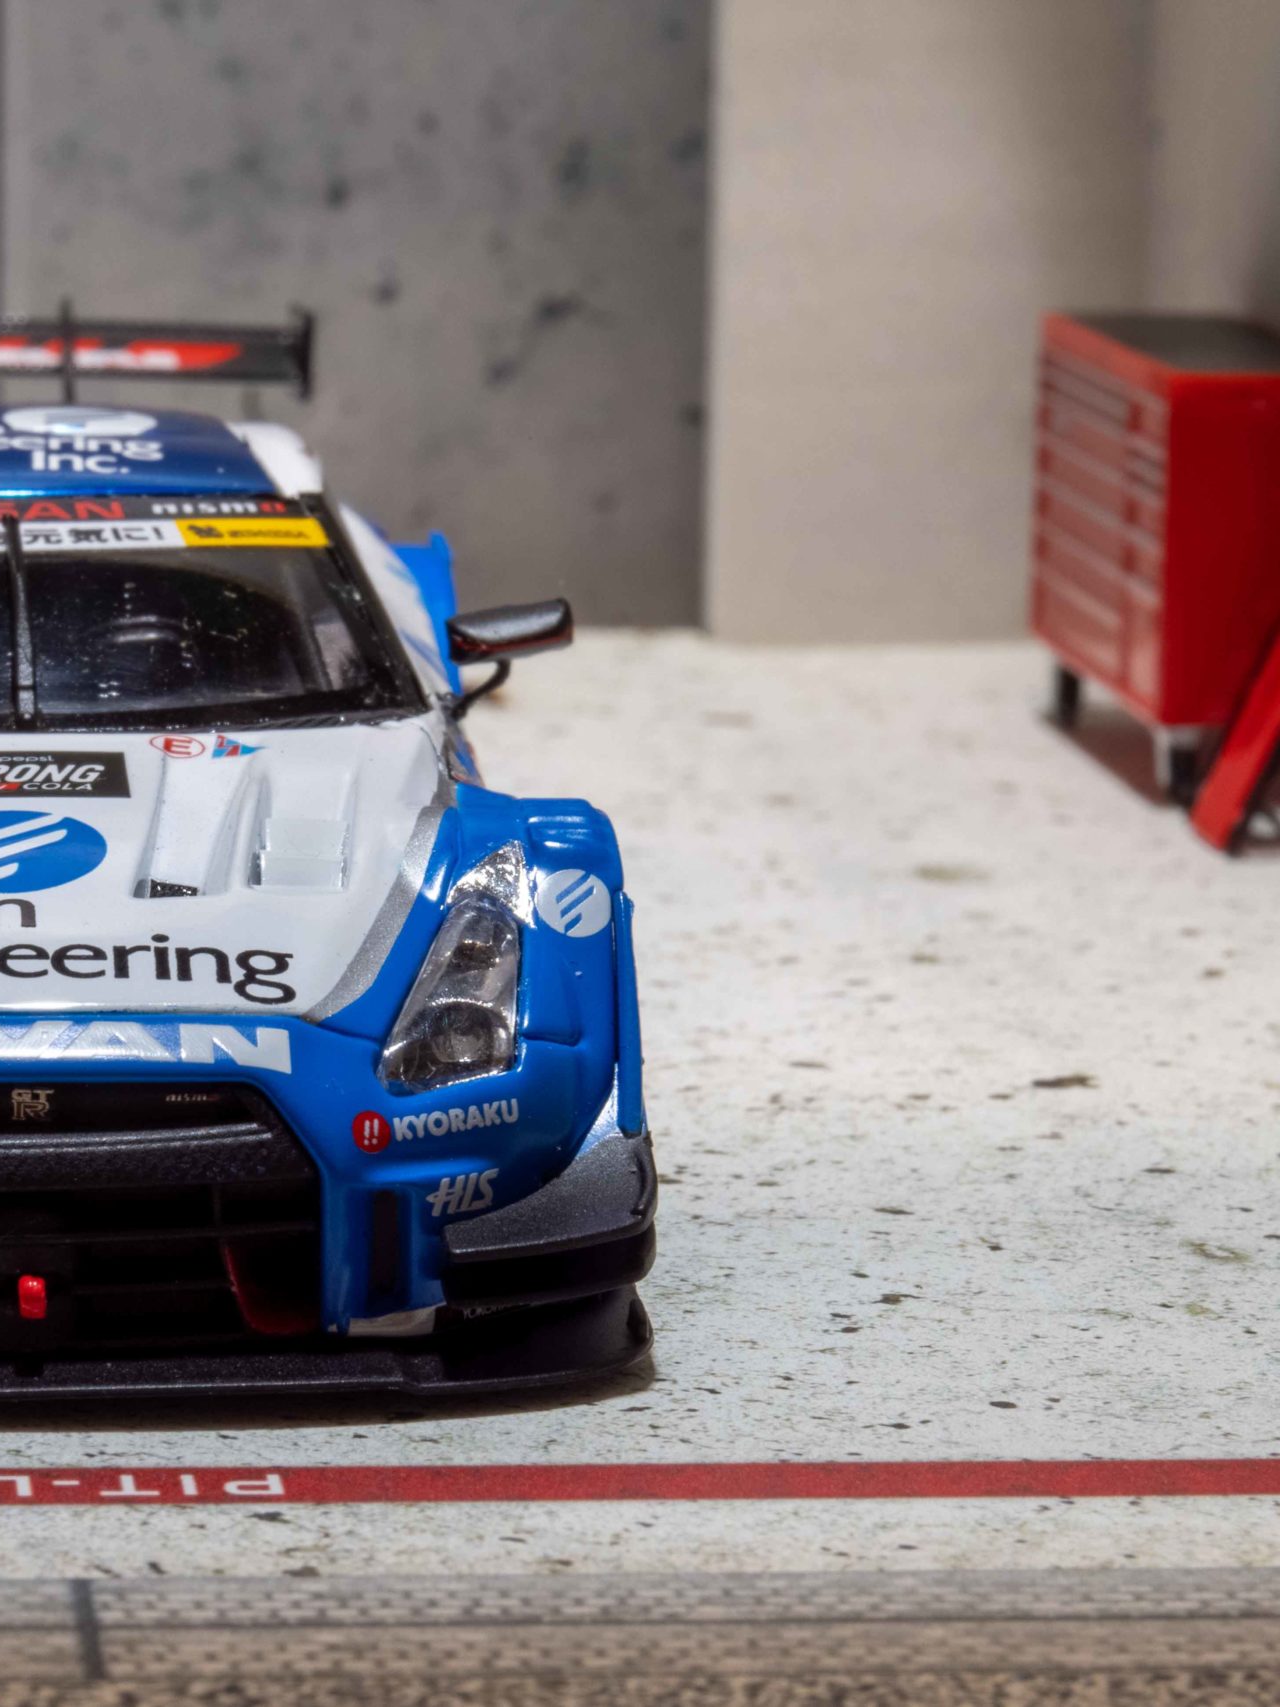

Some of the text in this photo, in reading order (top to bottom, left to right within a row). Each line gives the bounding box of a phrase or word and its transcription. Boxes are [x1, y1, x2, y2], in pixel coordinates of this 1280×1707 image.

[30, 450, 130, 475] Inc.
[22, 782, 94, 791] COLA
[393, 1098, 519, 1142] KYORAKU
